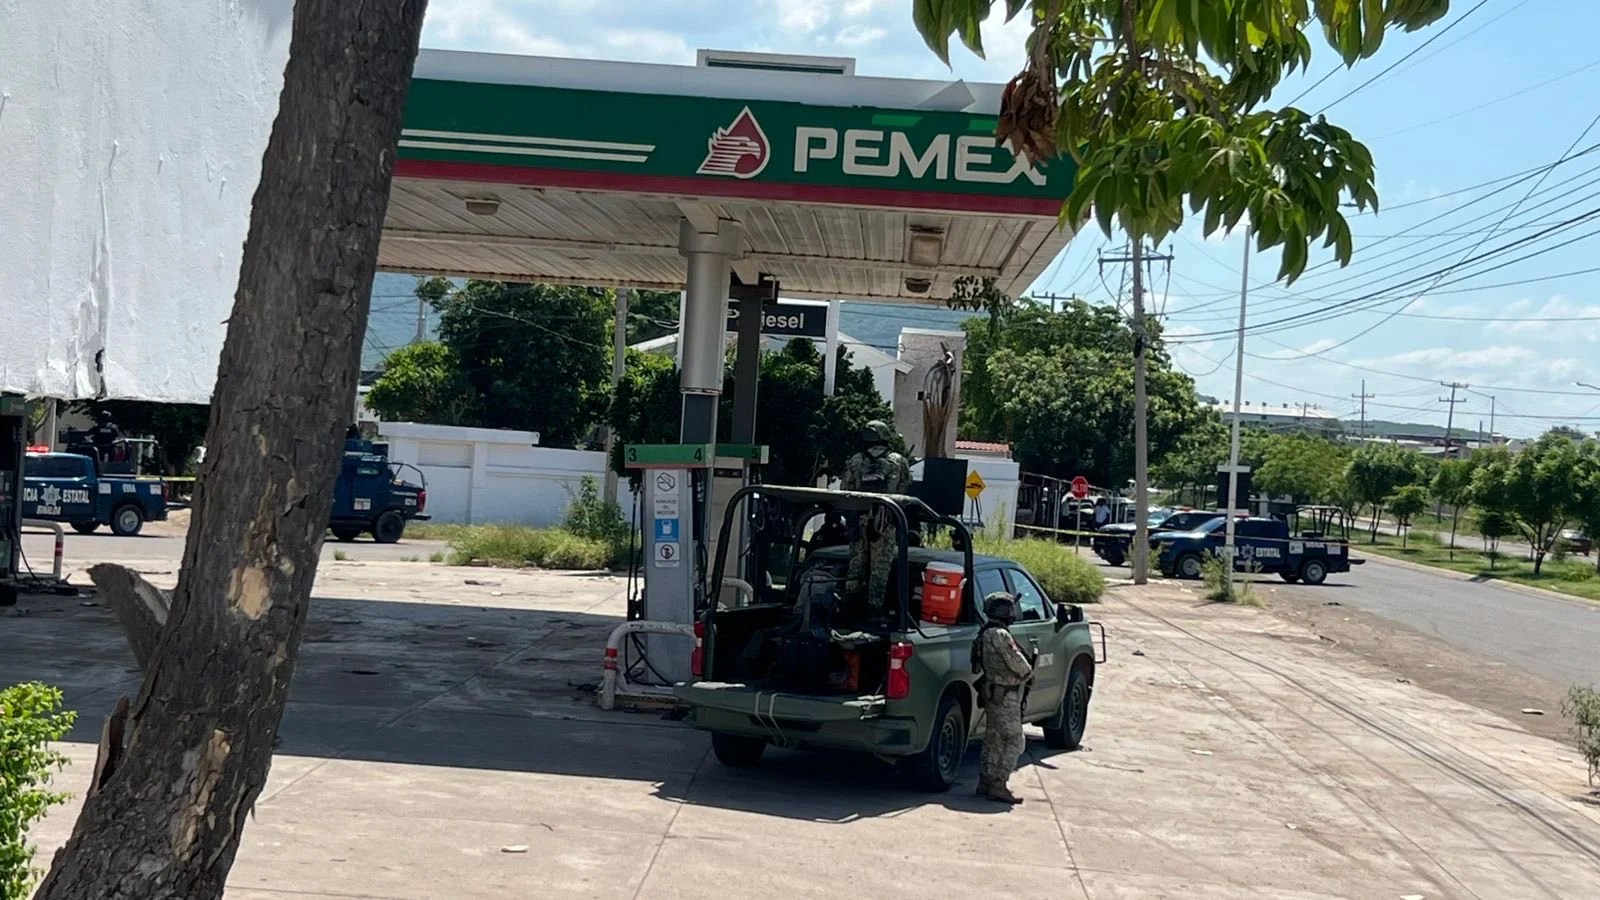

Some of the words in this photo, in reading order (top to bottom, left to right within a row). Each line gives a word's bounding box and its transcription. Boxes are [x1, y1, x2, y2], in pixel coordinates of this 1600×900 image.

[794, 126, 1047, 186] PEMEX
[761, 312, 804, 329] iesel
[628, 448, 637, 462] 3
[694, 448, 703, 462] 4
[23, 488, 38, 501] ICIA
[62, 489, 90, 503] ESTATAL
